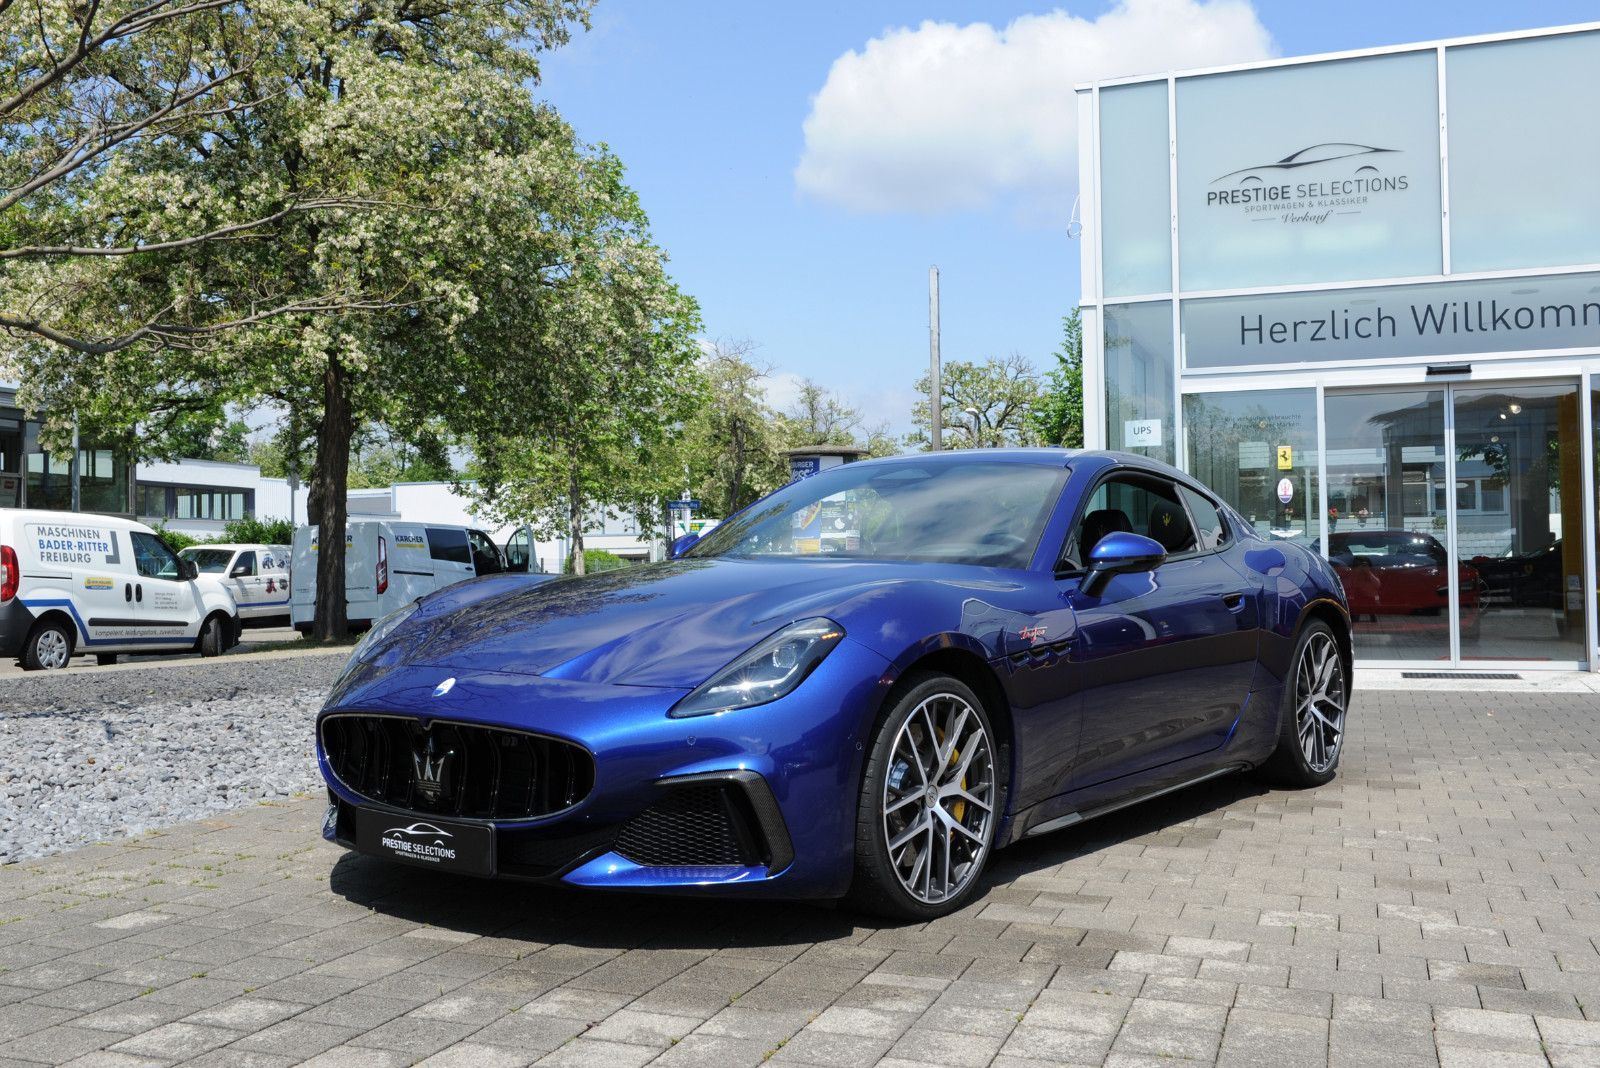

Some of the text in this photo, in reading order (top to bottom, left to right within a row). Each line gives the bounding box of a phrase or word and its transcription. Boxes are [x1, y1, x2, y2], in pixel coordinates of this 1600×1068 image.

[1207, 175, 1409, 206] PRESTIGE SELECTIONS
[1244, 196, 1368, 213] SPORTWAGEN & KLASSIKER
[1281, 209, 1334, 225] Verkauf
[1240, 307, 1396, 345] Herzlich
[1133, 426, 1152, 435] UPS
[37, 526, 100, 539] MASCHINEN
[38, 539, 109, 552] BADER-RITTER
[40, 552, 91, 563] FREIBURG
[382, 837, 456, 859] PRESTIGE SELECTIONS
